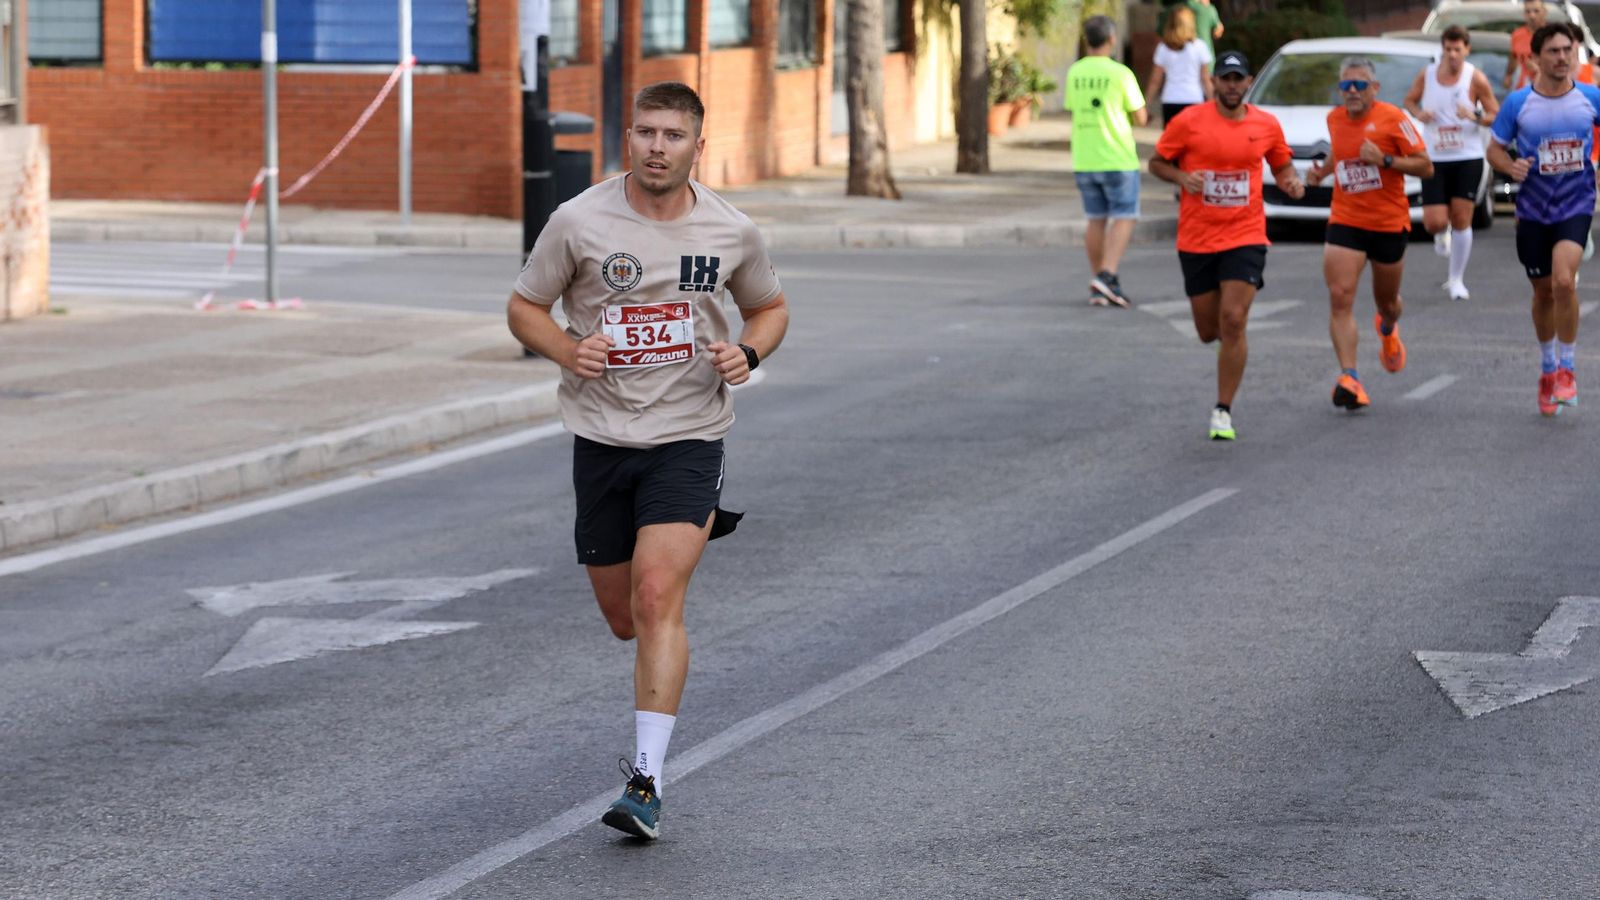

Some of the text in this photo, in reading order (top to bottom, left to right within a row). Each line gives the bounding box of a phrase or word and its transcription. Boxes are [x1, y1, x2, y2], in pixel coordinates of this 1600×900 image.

[1214, 182, 1238, 195] 494
[680, 255, 720, 284] IX
[678, 284, 716, 293] CIA
[625, 324, 672, 347] 534
